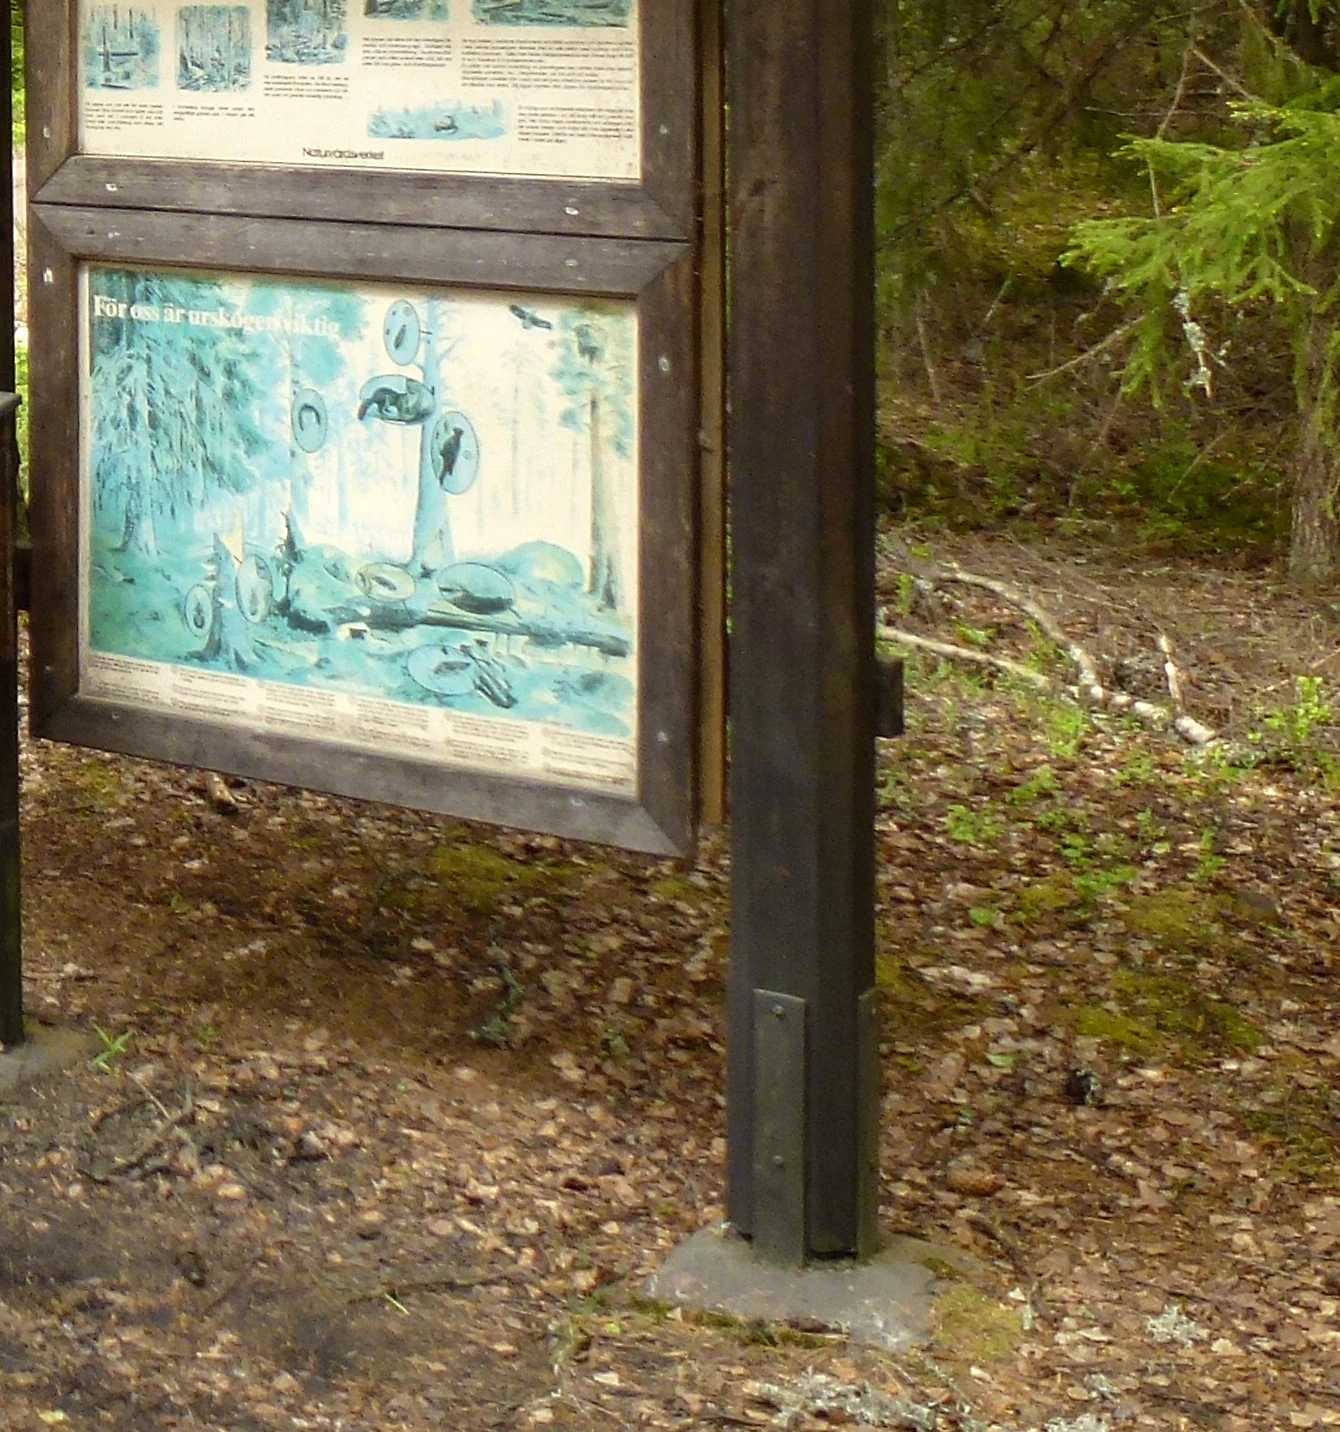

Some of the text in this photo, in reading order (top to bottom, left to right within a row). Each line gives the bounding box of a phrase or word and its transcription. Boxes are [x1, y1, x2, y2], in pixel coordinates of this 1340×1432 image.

[93, 295, 340, 338] För oss är urskogen viktig
